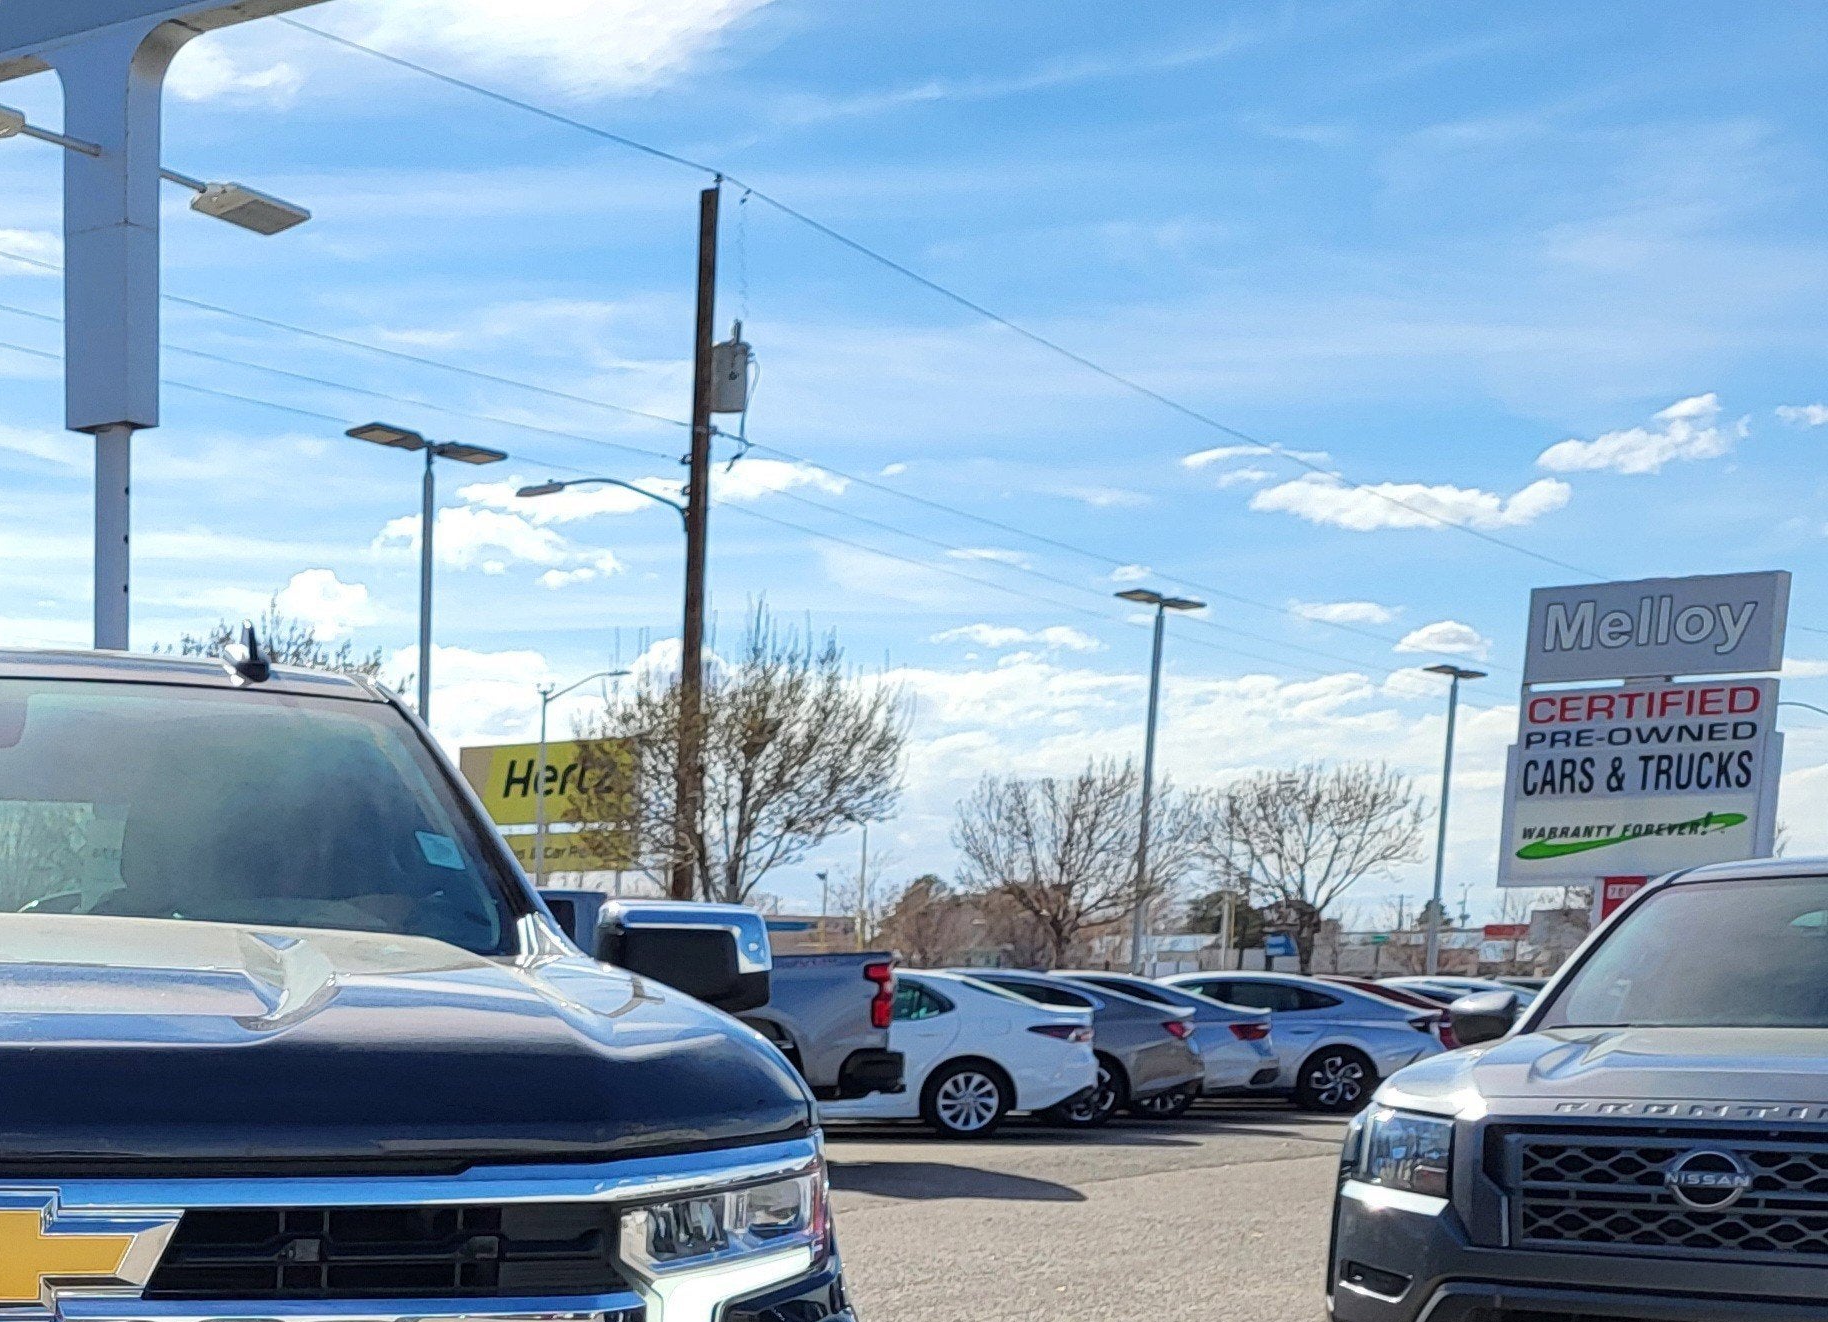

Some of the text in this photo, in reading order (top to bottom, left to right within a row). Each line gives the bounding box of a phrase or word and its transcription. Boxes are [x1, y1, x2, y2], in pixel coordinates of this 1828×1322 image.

[1543, 594, 1759, 655] Melloy
[1528, 686, 1761, 724] CERTIFIED
[1524, 721, 1758, 750] PRE-OWNED
[502, 759, 614, 798] Hertz
[1523, 750, 1754, 796] CARS & TRUCKS
[1522, 823, 1616, 841] WARRANTY
[1665, 1172, 1751, 1187] NISSAN
